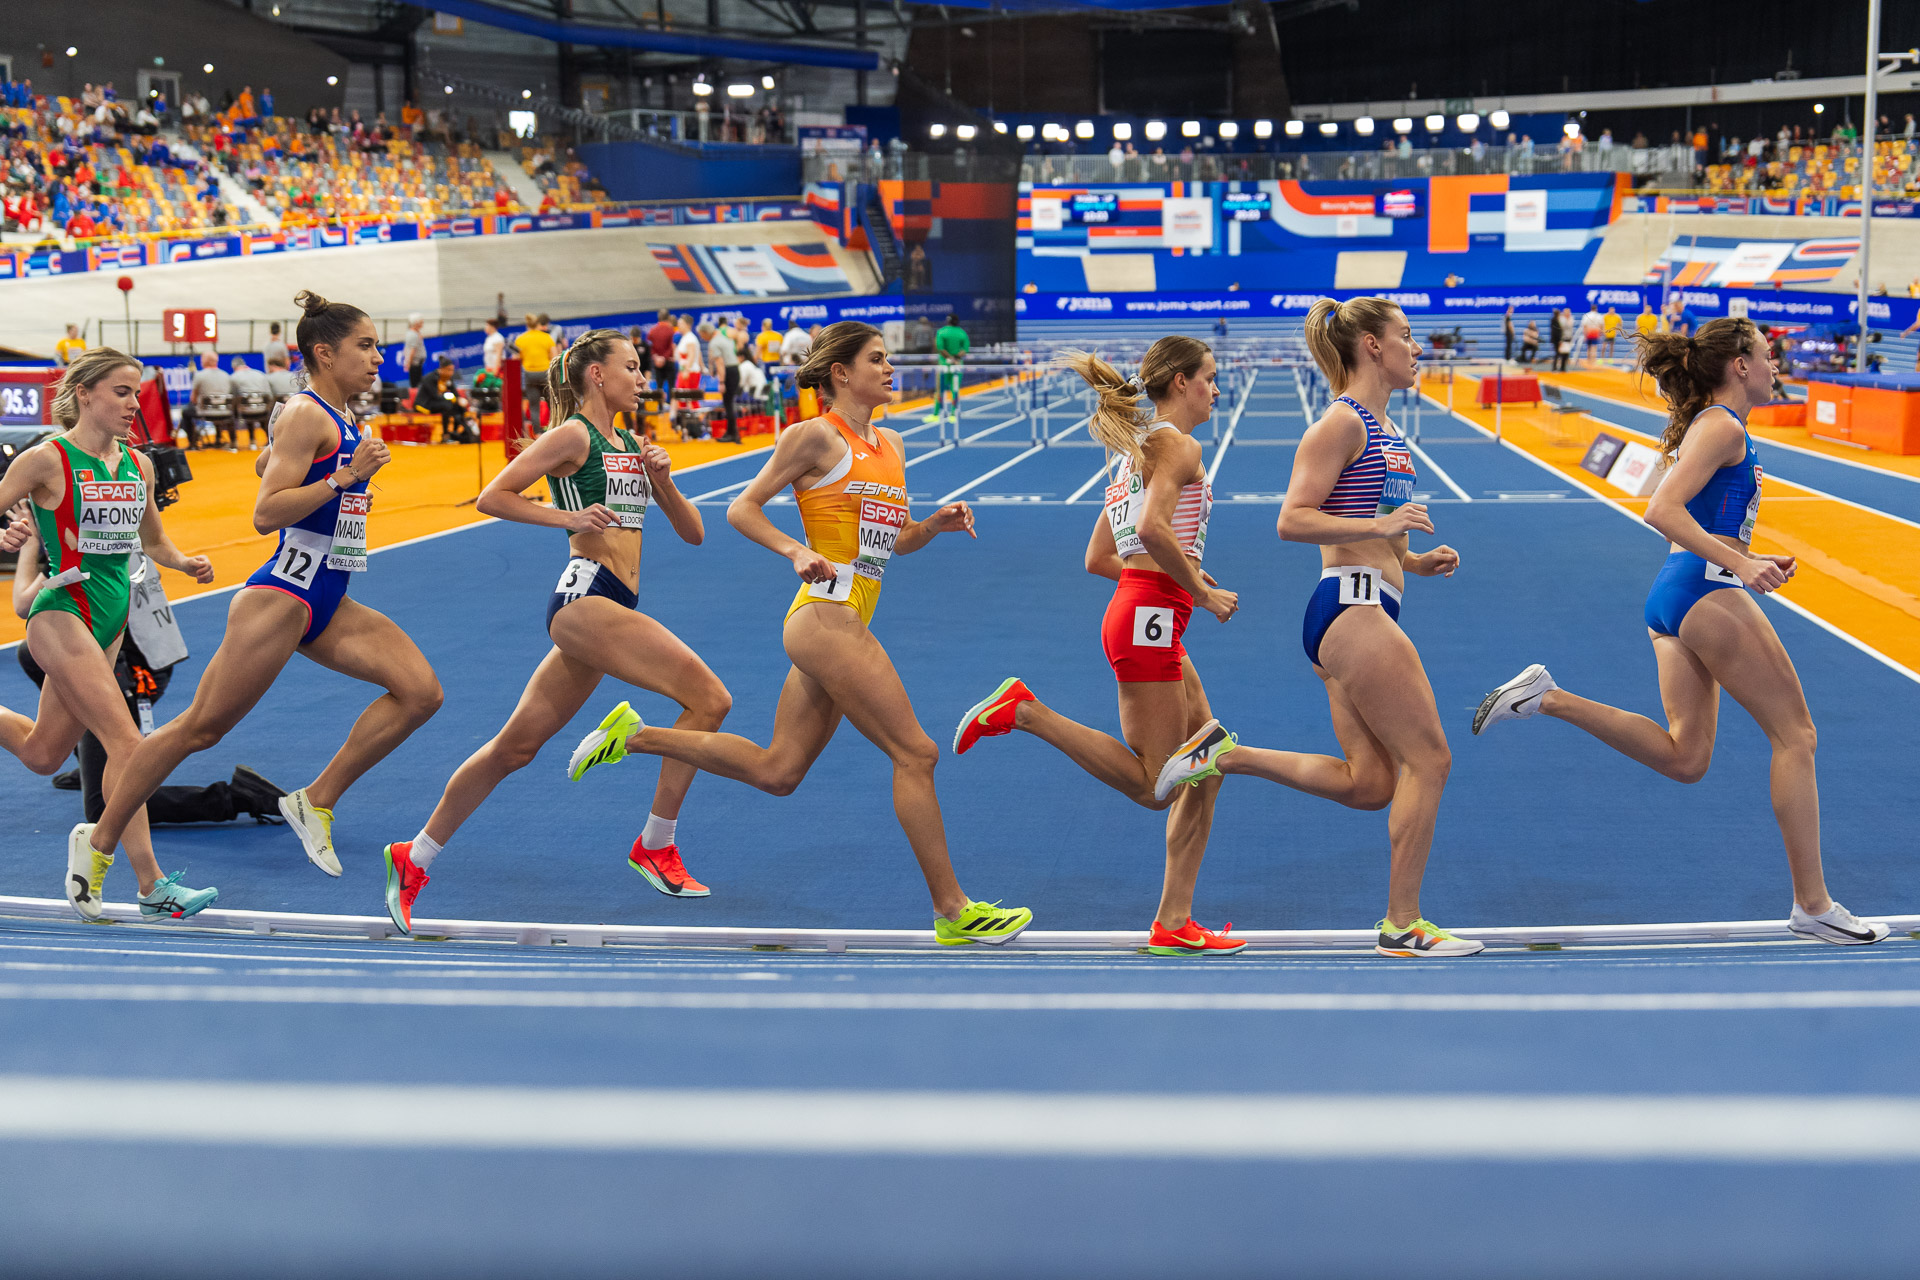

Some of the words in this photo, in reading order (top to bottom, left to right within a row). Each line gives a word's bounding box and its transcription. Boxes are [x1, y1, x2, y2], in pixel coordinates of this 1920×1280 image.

[1125, 300, 1250, 312] www.joma-sport.com
[1444, 295, 1567, 308] www.joma-sport.com
[606, 456, 642, 472] SPA
[83, 484, 135, 500] SPAR
[1105, 480, 1129, 504] SPAR
[864, 502, 906, 526] SPAR
[1111, 499, 1130, 529] 737
[81, 541, 133, 551] APELDOORN
[282, 546, 314, 582] 12
[565, 563, 581, 588] 3
[1350, 571, 1372, 601] 11
[152, 605, 172, 628] TV
[1144, 613, 1162, 641] 6
